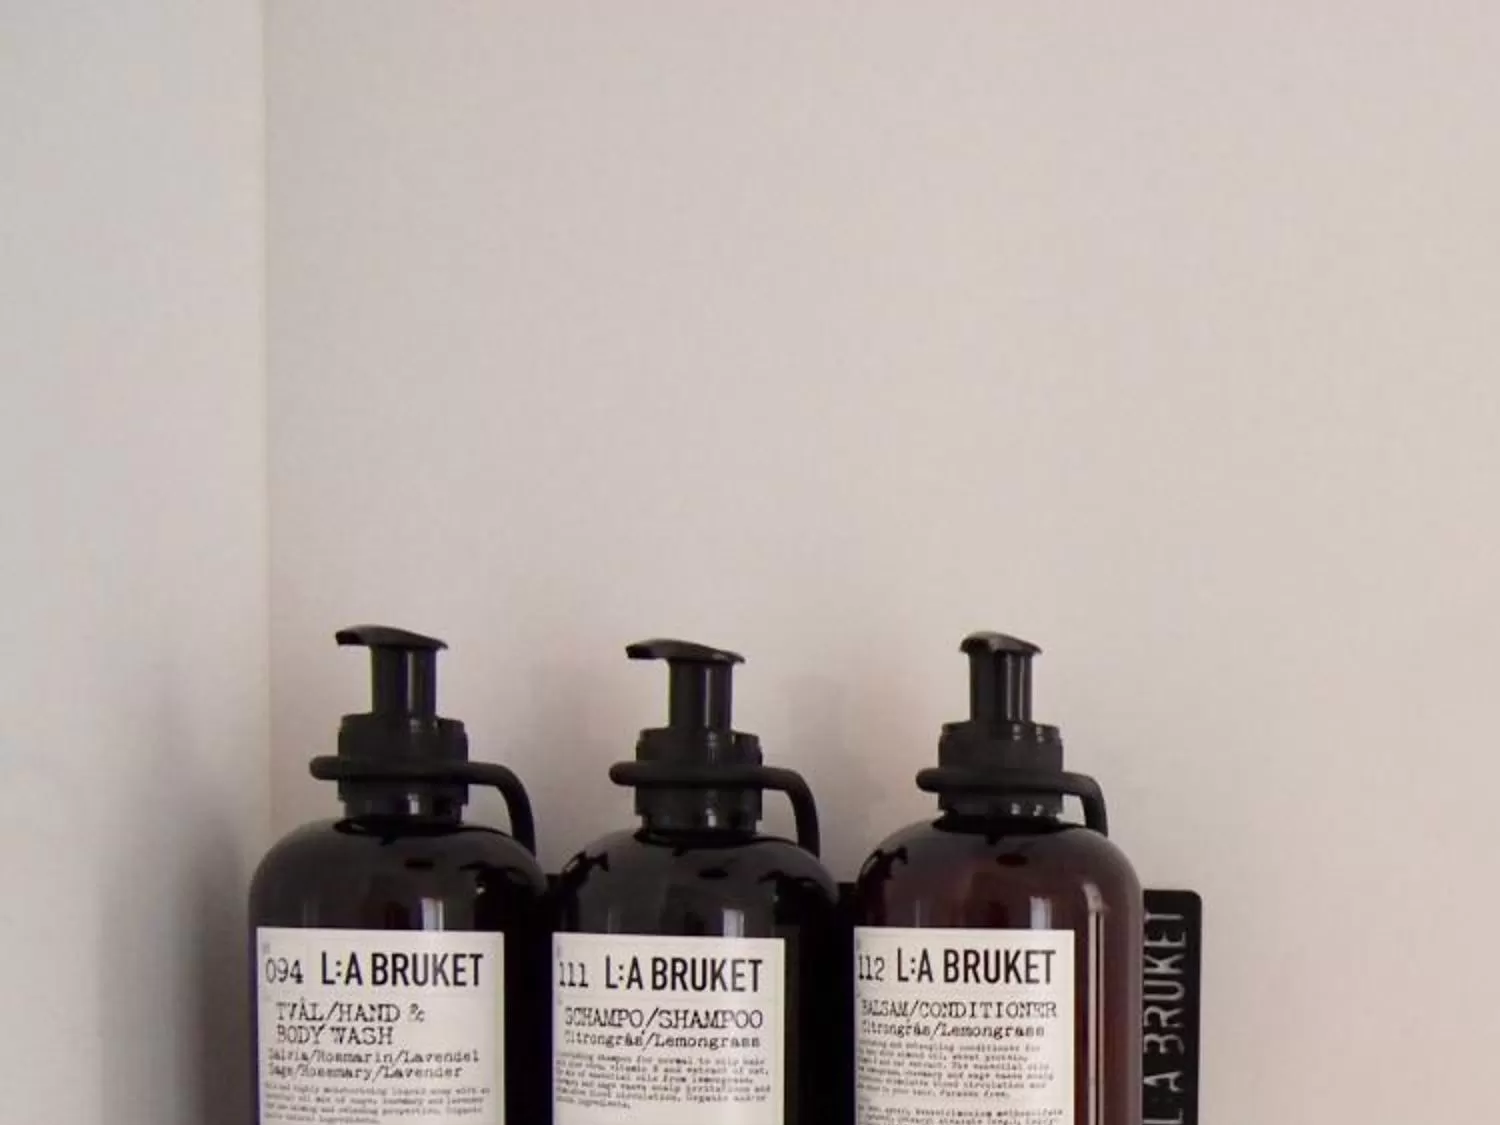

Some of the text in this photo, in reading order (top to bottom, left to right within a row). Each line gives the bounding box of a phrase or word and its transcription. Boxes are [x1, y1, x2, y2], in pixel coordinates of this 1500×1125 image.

[265, 951, 484, 987] 094 L:A BRUKET
[559, 954, 763, 992] 111 L:A BRUKET
[858, 947, 1056, 984] 112 L:A BRUKET
[564, 1006, 764, 1033] SCHAMPO/SHAMPOO
[862, 999, 1057, 1022] BALSAM/CONDITIONER
[277, 1024, 394, 1045] BODY WASH
